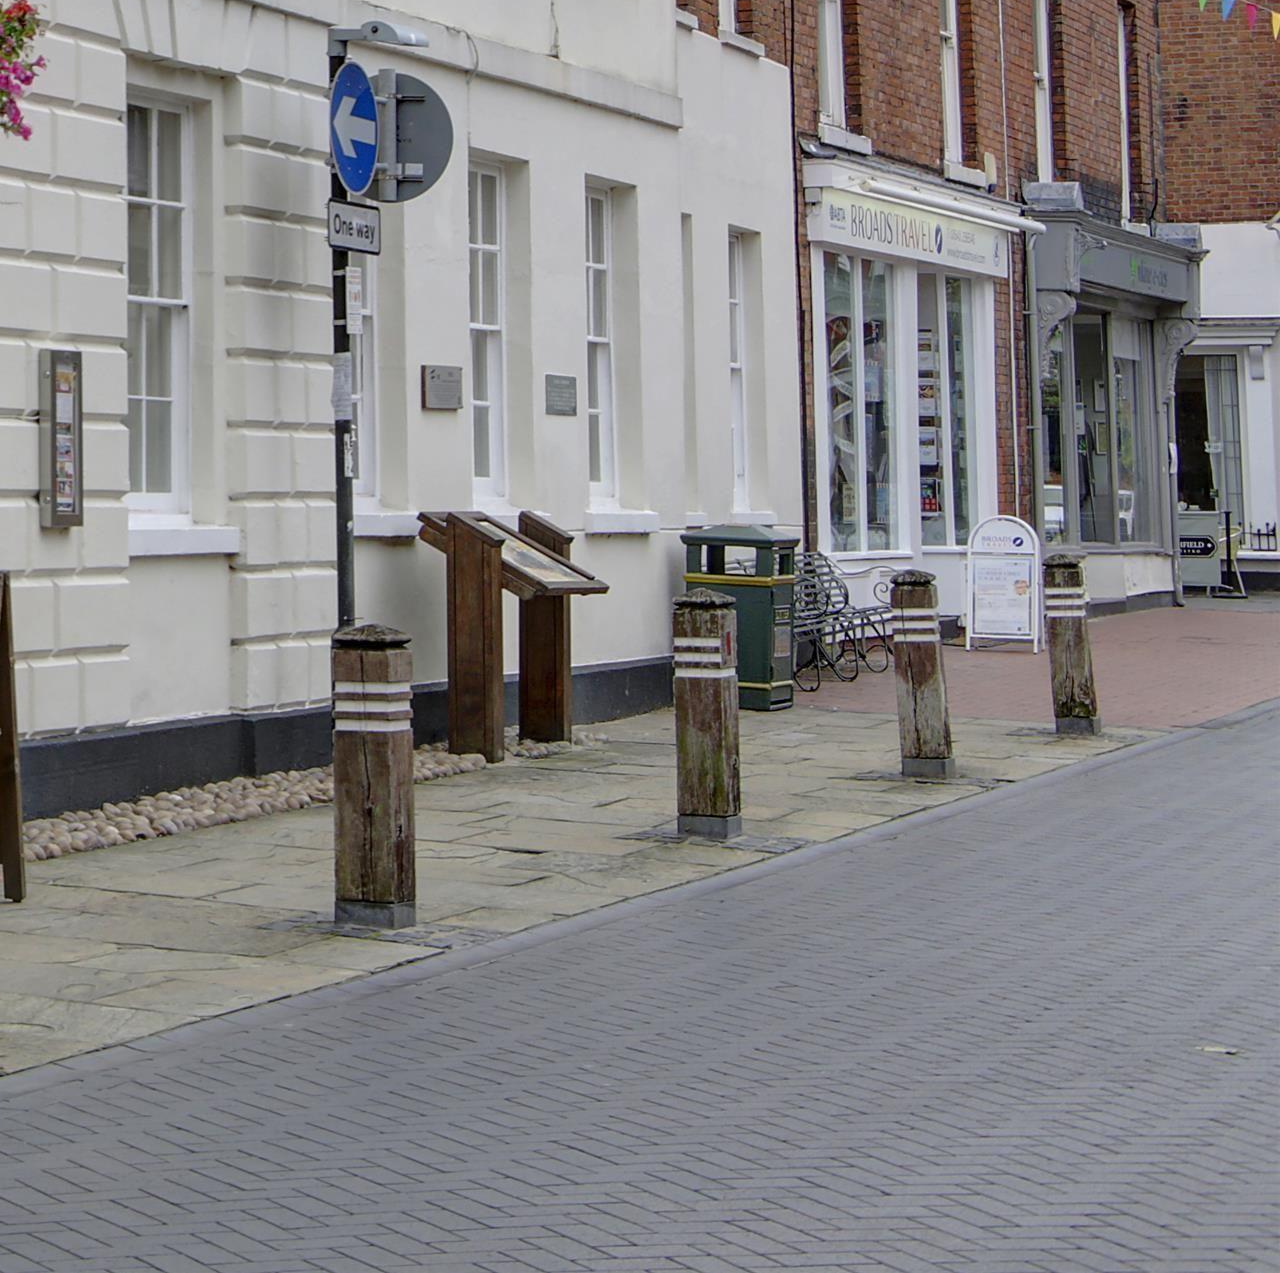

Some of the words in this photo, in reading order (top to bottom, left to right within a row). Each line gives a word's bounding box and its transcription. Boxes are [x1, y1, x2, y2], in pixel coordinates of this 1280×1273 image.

[333, 213, 354, 237] One
[356, 223, 376, 245] way
[851, 204, 894, 245] BROADS
[894, 215, 934, 253] TRAVEL
